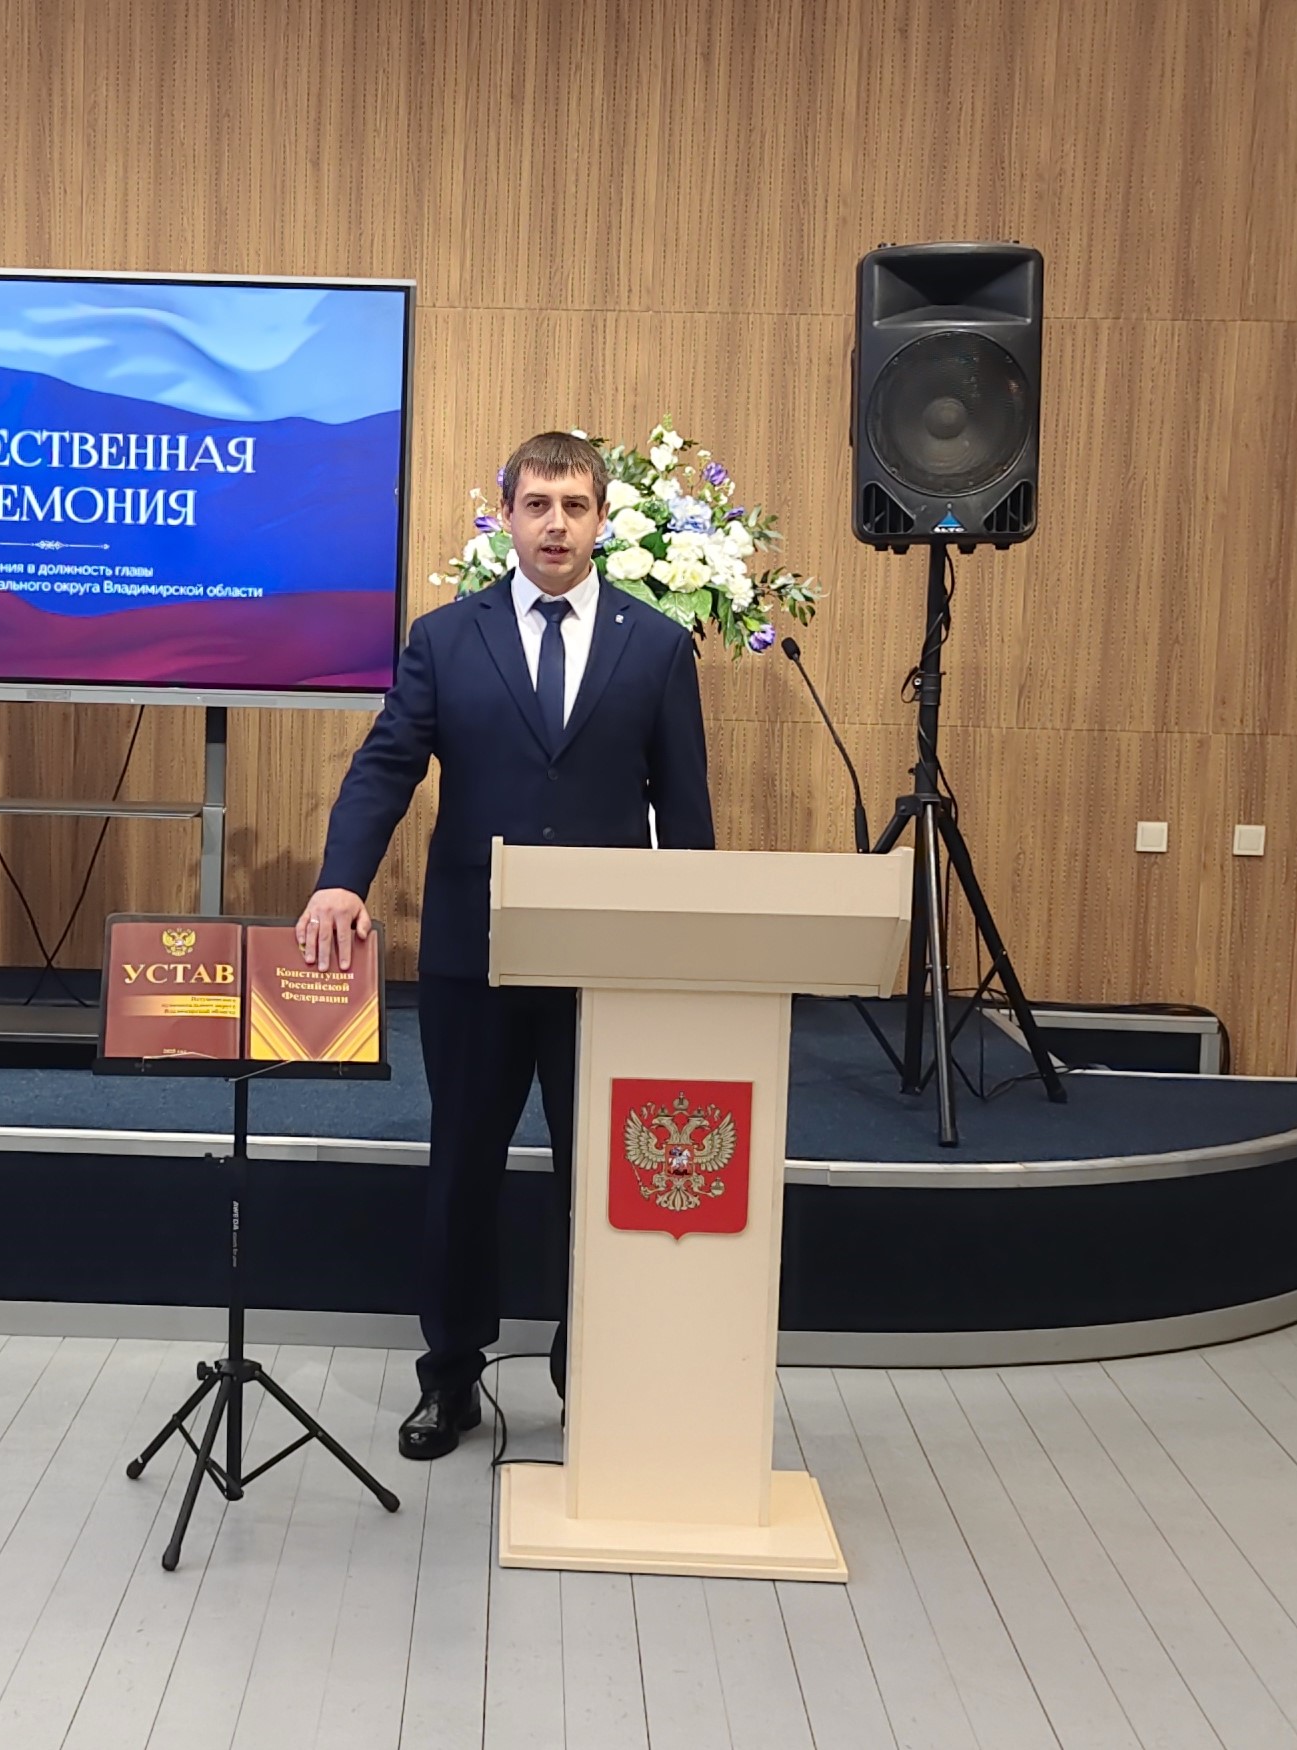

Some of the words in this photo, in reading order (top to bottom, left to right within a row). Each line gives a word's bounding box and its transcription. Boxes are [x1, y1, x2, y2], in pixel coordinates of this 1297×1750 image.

[27, 564, 35, 574] в
[38, 563, 113, 577] должность
[115, 565, 154, 578] главы
[54, 581, 101, 596] округа
[104, 580, 204, 598] Владимирской
[206, 583, 263, 598] области
[122, 963, 235, 984] УСТАВ
[280, 979, 350, 992] Российской
[281, 991, 349, 1004] Федерации
